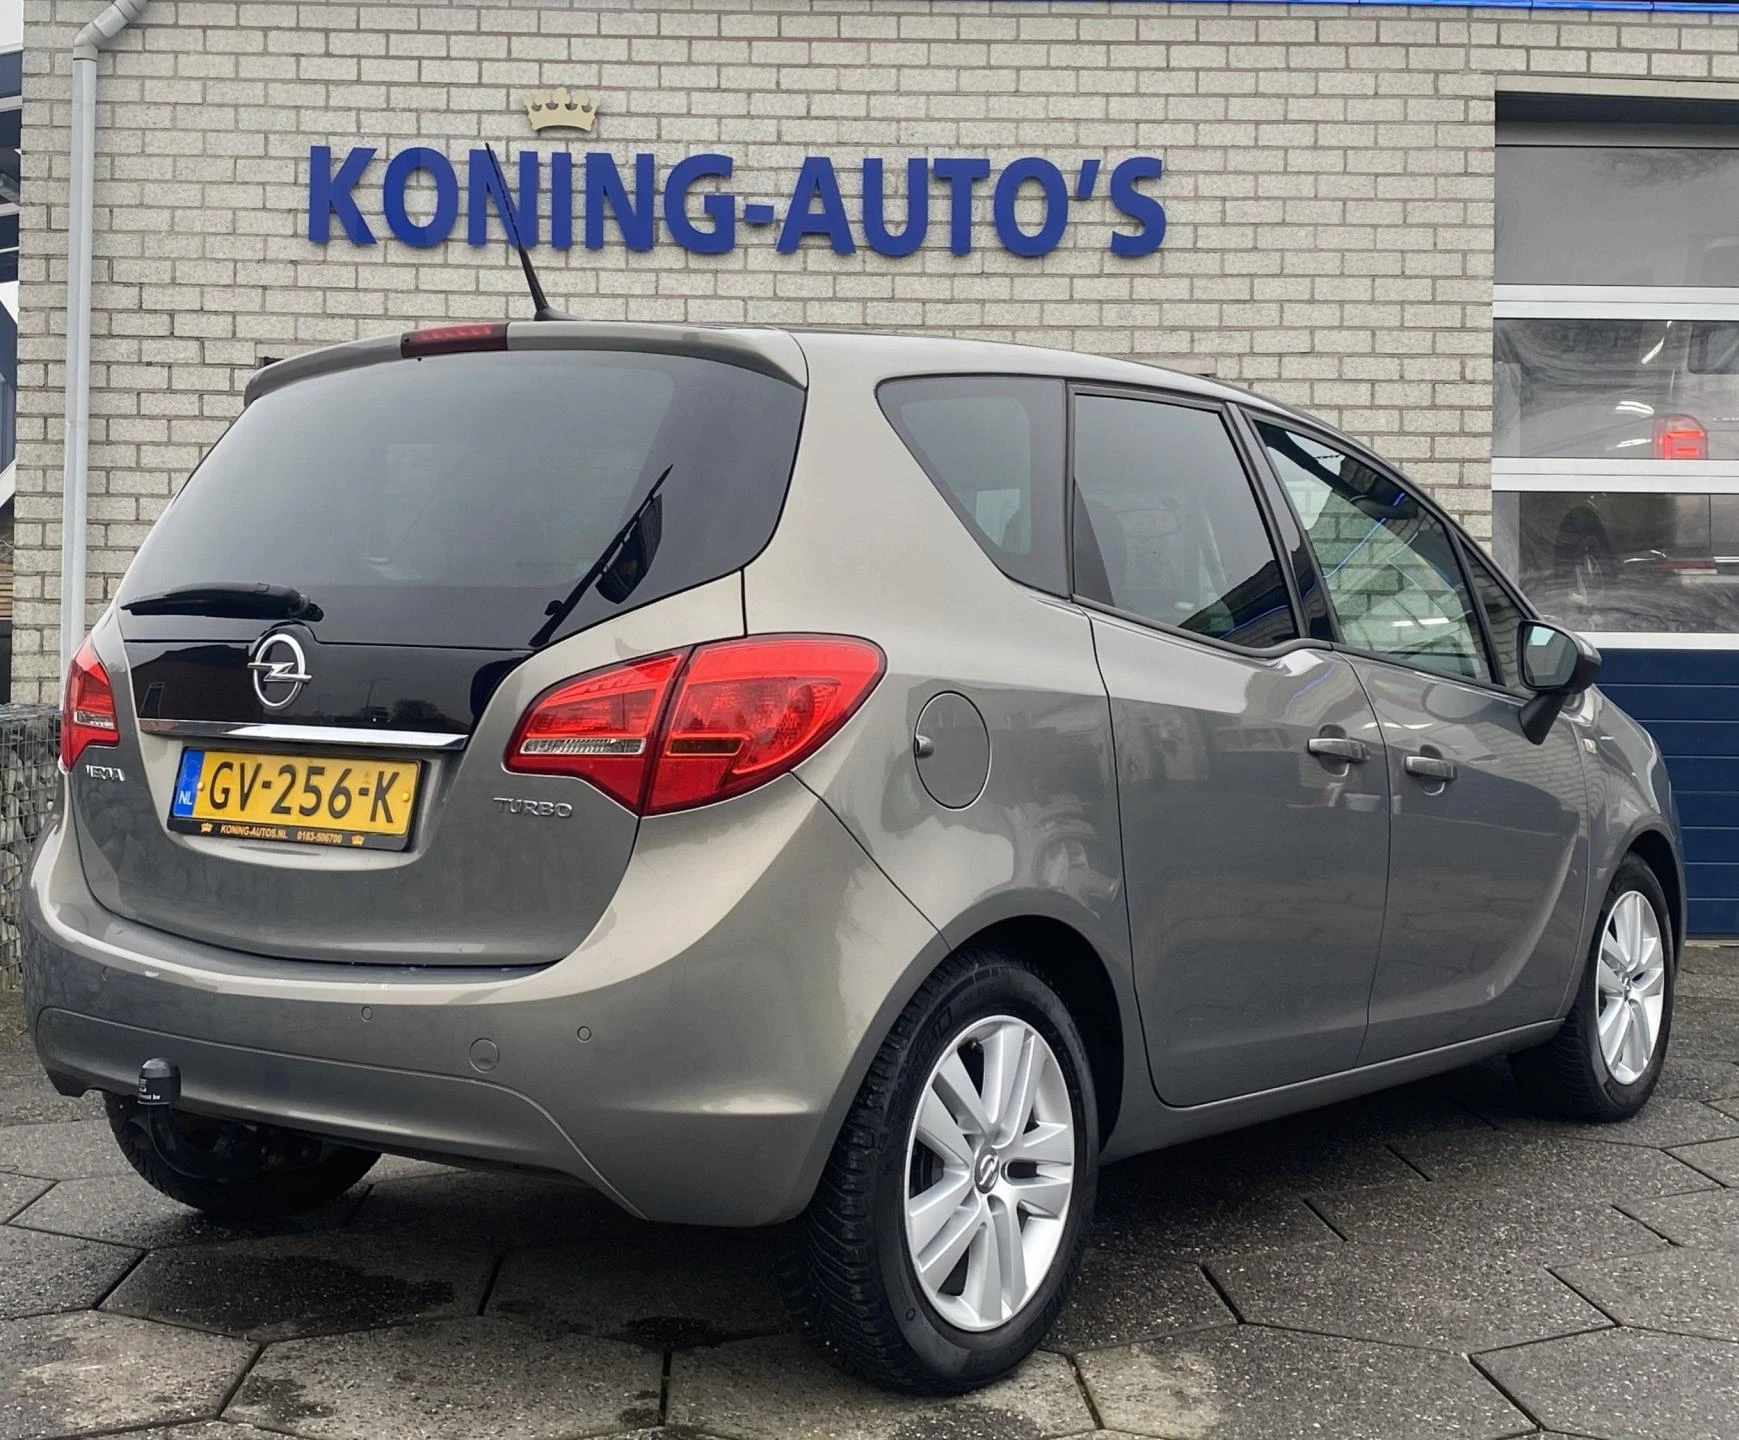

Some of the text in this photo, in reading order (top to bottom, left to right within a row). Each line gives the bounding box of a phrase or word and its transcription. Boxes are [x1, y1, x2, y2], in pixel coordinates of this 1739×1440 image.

[308, 145, 1167, 258] KONING-AUTO'S
[179, 790, 193, 806] NL
[209, 761, 400, 824] GV-256-K
[493, 797, 573, 818] TURBO
[220, 824, 288, 840] KONING-AUTOS.NL
